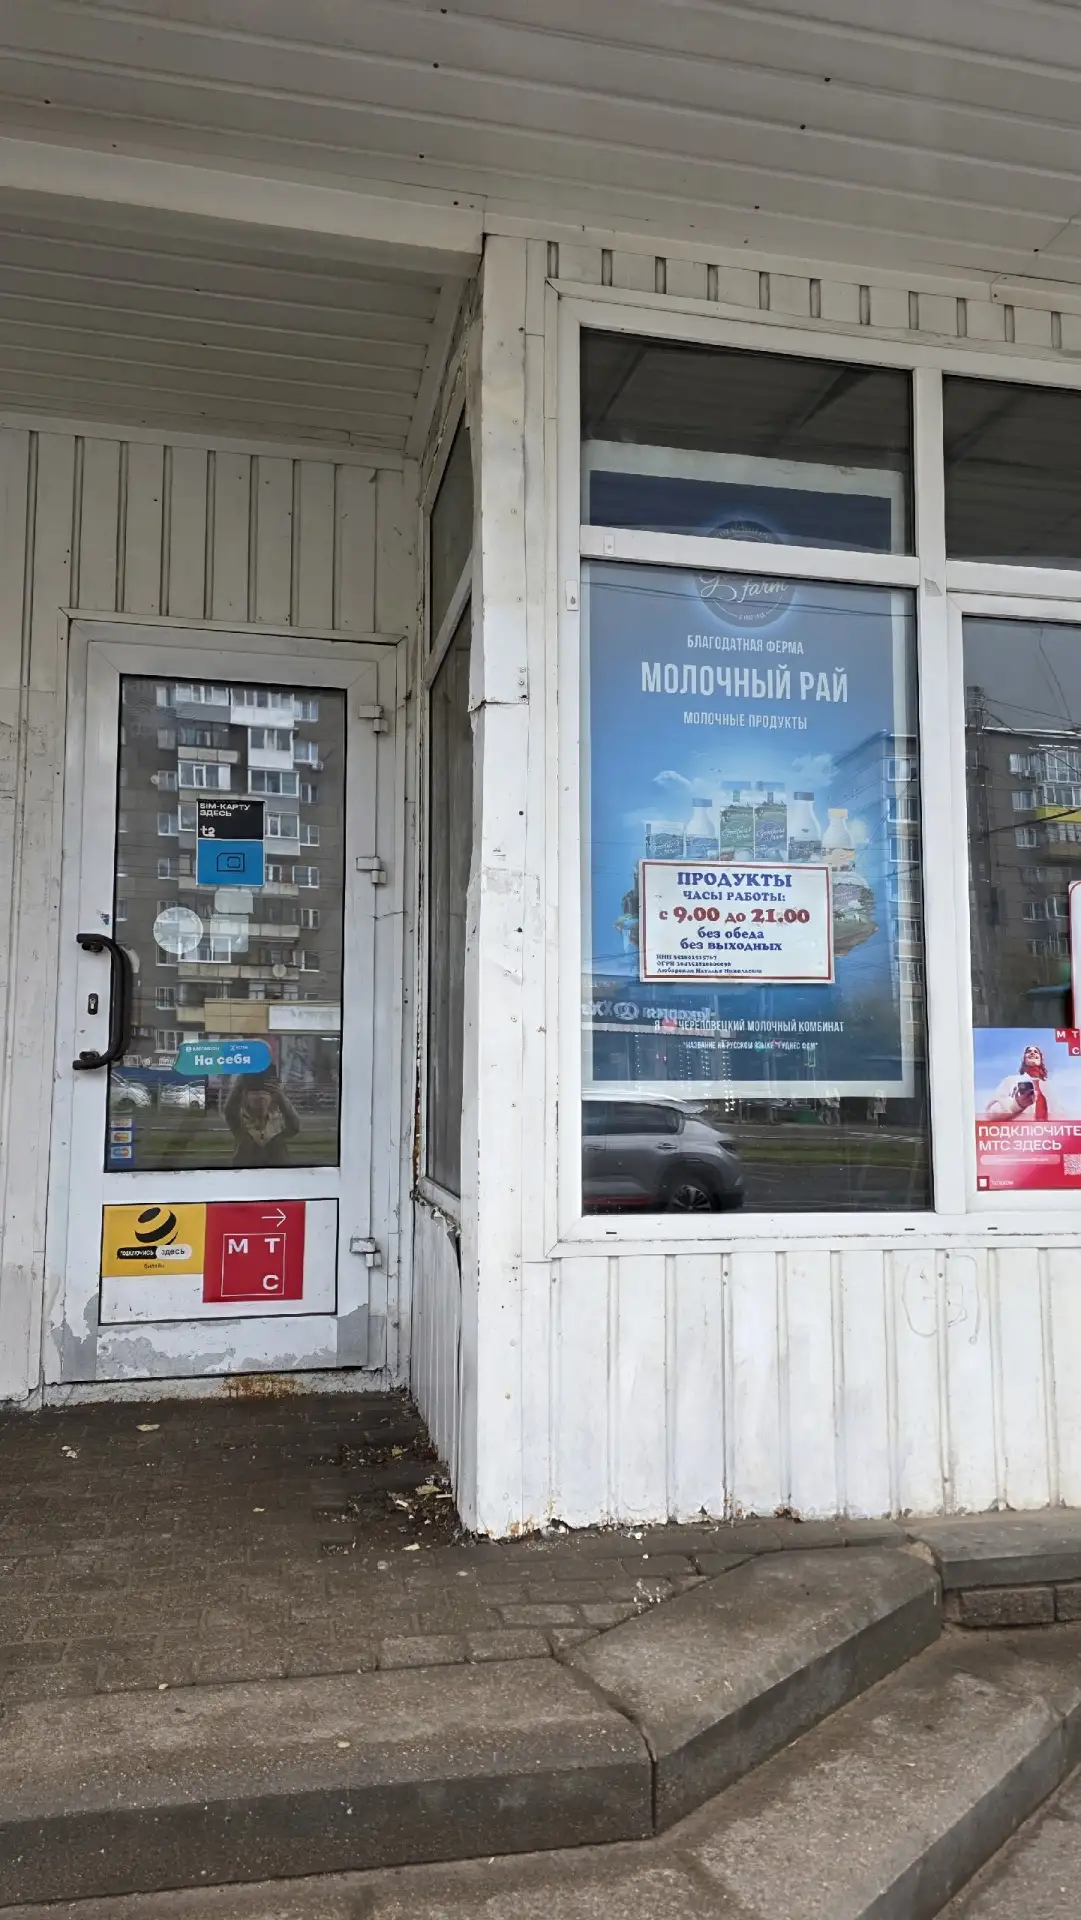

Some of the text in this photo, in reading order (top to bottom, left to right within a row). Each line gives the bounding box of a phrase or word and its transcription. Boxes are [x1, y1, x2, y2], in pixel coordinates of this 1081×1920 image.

[687, 635, 804, 655] БЛАГОДАТНАЯ ФЕРМА
[641, 662, 848, 703] МОЛОЧНЫЙ РАЙ
[683, 711, 807, 730] МОЛОЧНЫЕ ПРОДУКТЫ
[199, 803, 251, 811] SIM-КАРТУ
[199, 810, 232, 818] ЗДЕСЬ
[199, 825, 216, 838] t2
[677, 872, 792, 888] ПРОДУКТЫ
[682, 890, 786, 902] ЧАСЫ РАБОТЫ:
[659, 906, 810, 924] с 9.00 до 21.00
[697, 926, 764, 939] без обеда
[680, 938, 782, 951] без выходных
[655, 1019, 845, 1032] Я ЧЕРЕПОВЕЦКИЙ МОЛОЧНЫЙ КОМБИНАТ
[194, 1053, 252, 1066] На себя
[978, 1125, 1081, 1139] ПОДКЛЮЧИТЕ
[979, 1140, 1063, 1152] МТС ЗДЕСЬ
